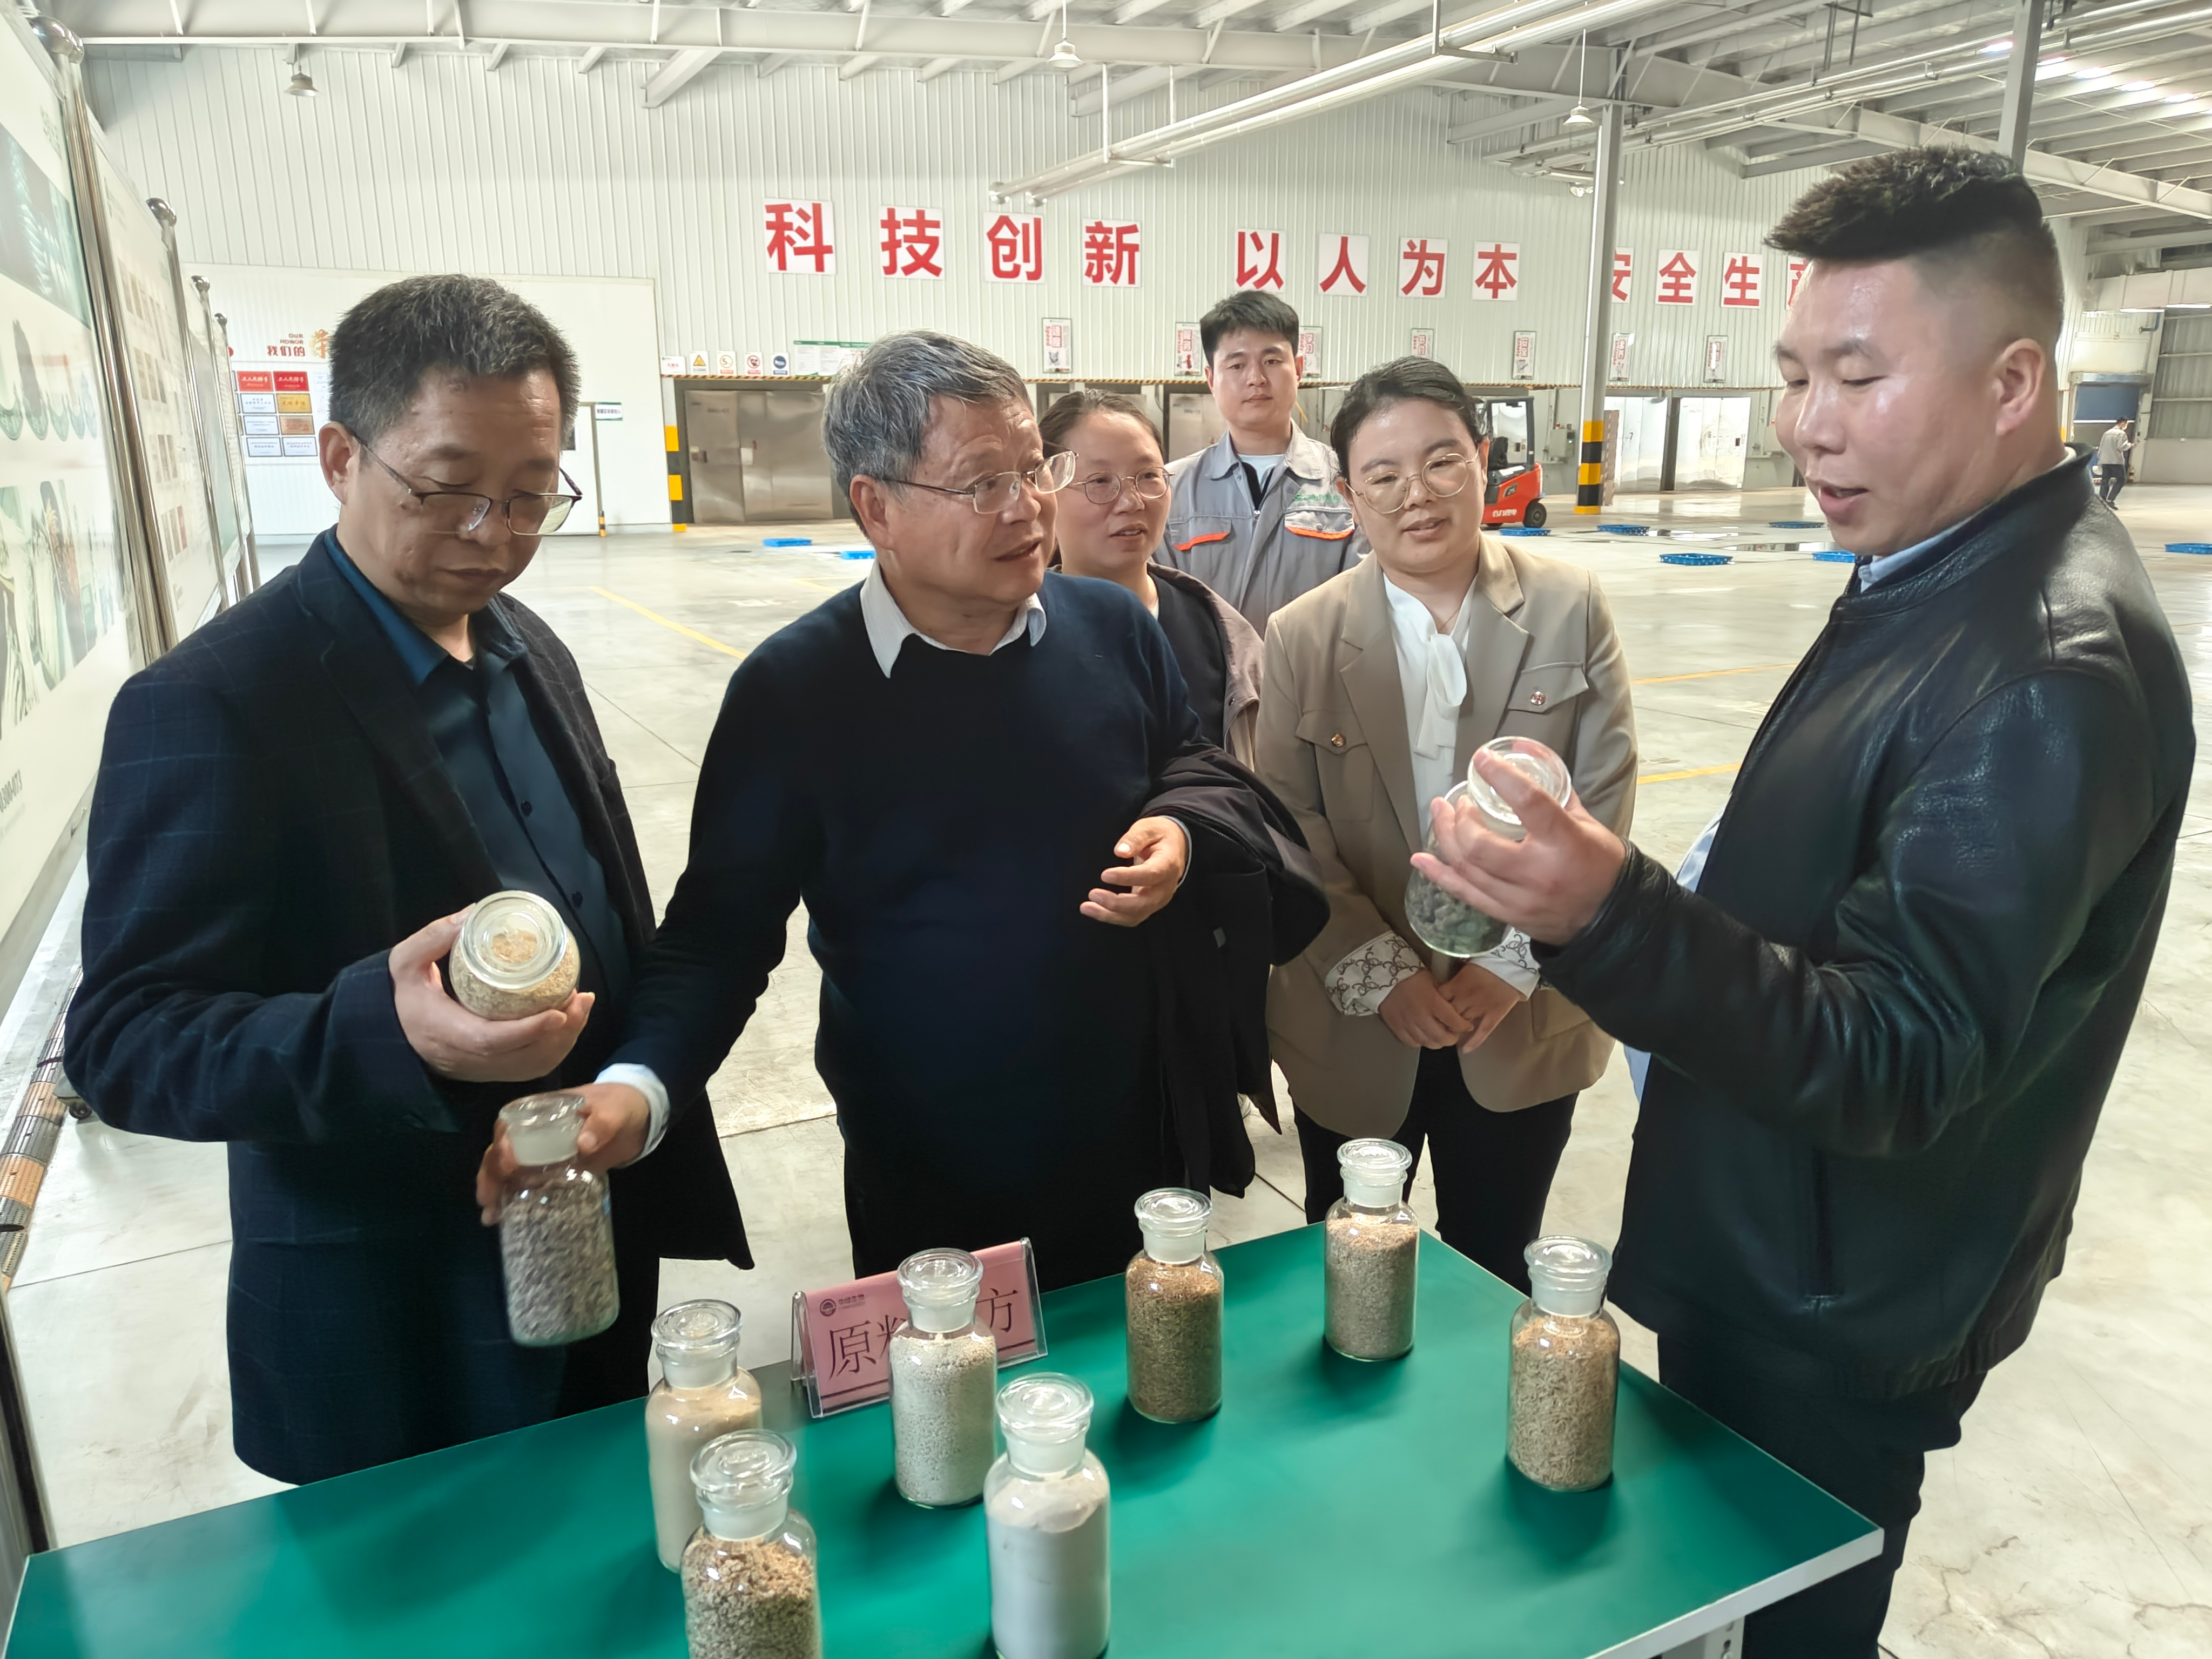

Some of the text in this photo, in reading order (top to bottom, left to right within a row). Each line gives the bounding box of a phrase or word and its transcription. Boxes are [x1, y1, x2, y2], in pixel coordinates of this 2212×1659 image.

[765, 202, 1139, 285] 科技创新
[1235, 231, 1518, 299] 以人为本
[267, 346, 306, 356] 我们的
[828, 1287, 1019, 1380] 原方
